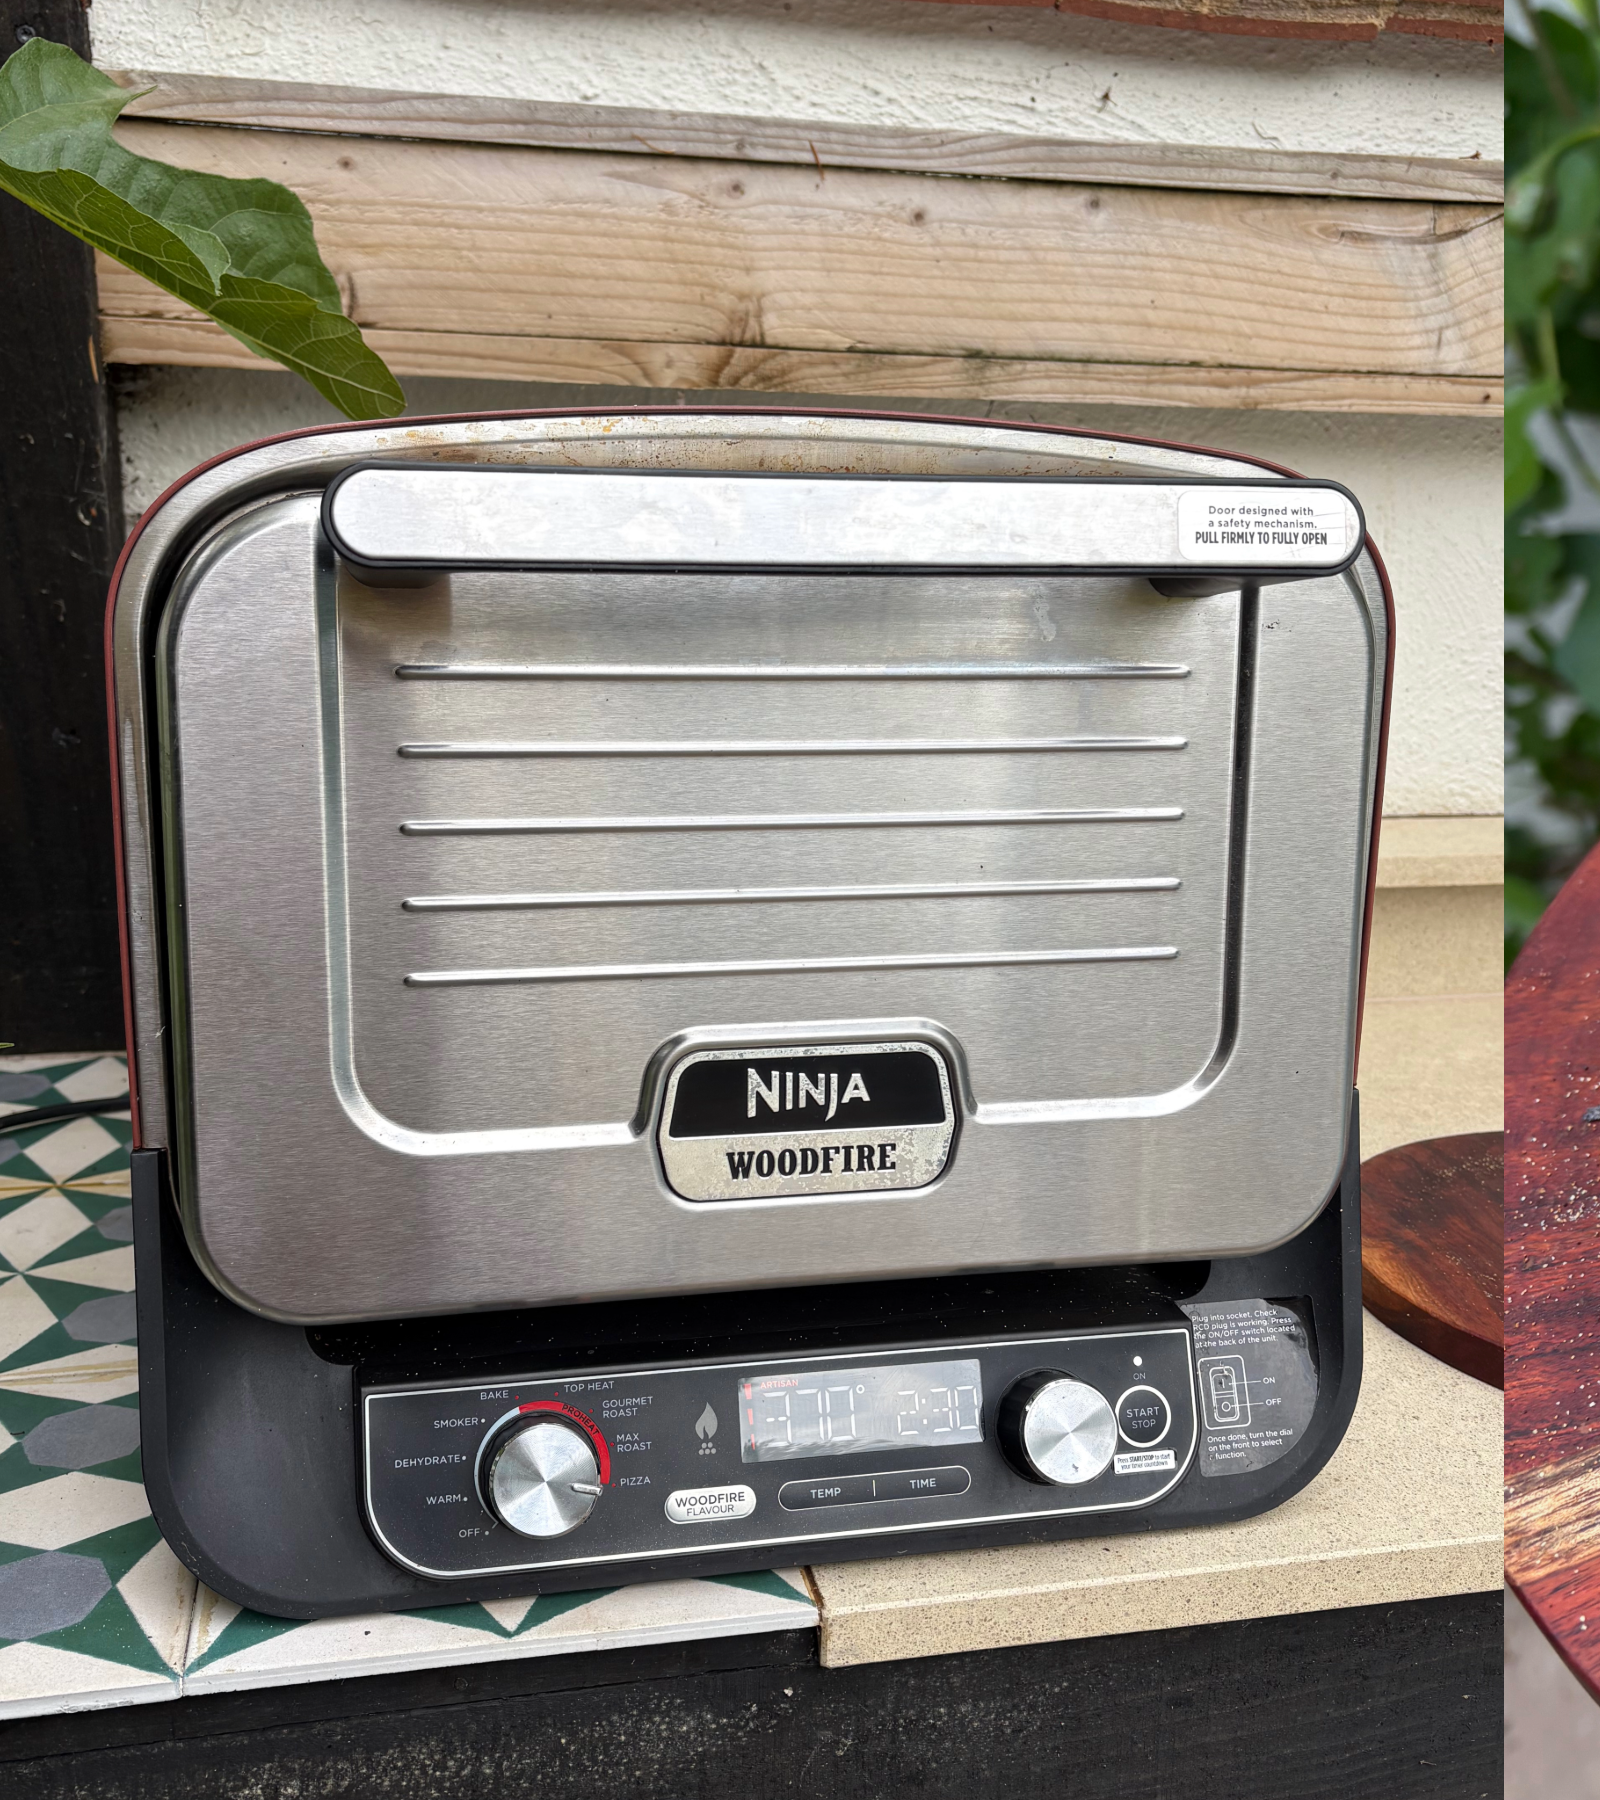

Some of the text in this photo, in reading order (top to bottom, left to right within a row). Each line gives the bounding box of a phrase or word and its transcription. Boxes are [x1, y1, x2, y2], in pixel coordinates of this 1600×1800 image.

[1208, 505, 1314, 517] Door designed with
[1208, 518, 1318, 530] a safety mechanism.
[1195, 531, 1328, 545] PULL FIRMLY TO FULLY OPEN
[747, 1067, 871, 1122] NINJA
[726, 1142, 897, 1182] WOODFIRE
[1254, 1309, 1277, 1317] Check
[1212, 1322, 1227, 1331] plug
[1237, 1318, 1269, 1328] working.
[1208, 1330, 1239, 1338] ON/OFF
[1241, 1327, 1265, 1335] switch
[1266, 1324, 1295, 1333] located
[1219, 1338, 1236, 1346] back
[1133, 1373, 1146, 1381] ON
[1263, 1377, 1276, 1385] ON
[564, 1381, 615, 1393] TOP HEAT
[760, 1379, 799, 1390] ARTISAN
[480, 1390, 509, 1400] BAKE
[602, 1396, 653, 1409] GOURMET
[1265, 1398, 1281, 1406] OFF
[602, 1408, 638, 1418] ROAST
[897, 1385, 979, 1436] 2:30
[1126, 1407, 1159, 1418] START
[433, 1417, 479, 1429] SMOKER
[561, 1404, 600, 1436] PROHEAT
[1132, 1419, 1156, 1429] STOP
[616, 1433, 640, 1442] MAX
[1280, 1428, 1293, 1436] dial
[617, 1441, 652, 1453] ROAST
[1232, 1441, 1250, 1449] front
[1261, 1438, 1283, 1446] select
[394, 1454, 461, 1468] DEHYDRATE
[1215, 1451, 1247, 1460] function.
[620, 1476, 651, 1487] PIZZA
[810, 1477, 937, 1499] TEMP TIME
[426, 1494, 461, 1505] WARM
[675, 1491, 745, 1508] WOODFIRE
[686, 1504, 735, 1517] FLAVOUR
[458, 1527, 480, 1538] OFF
